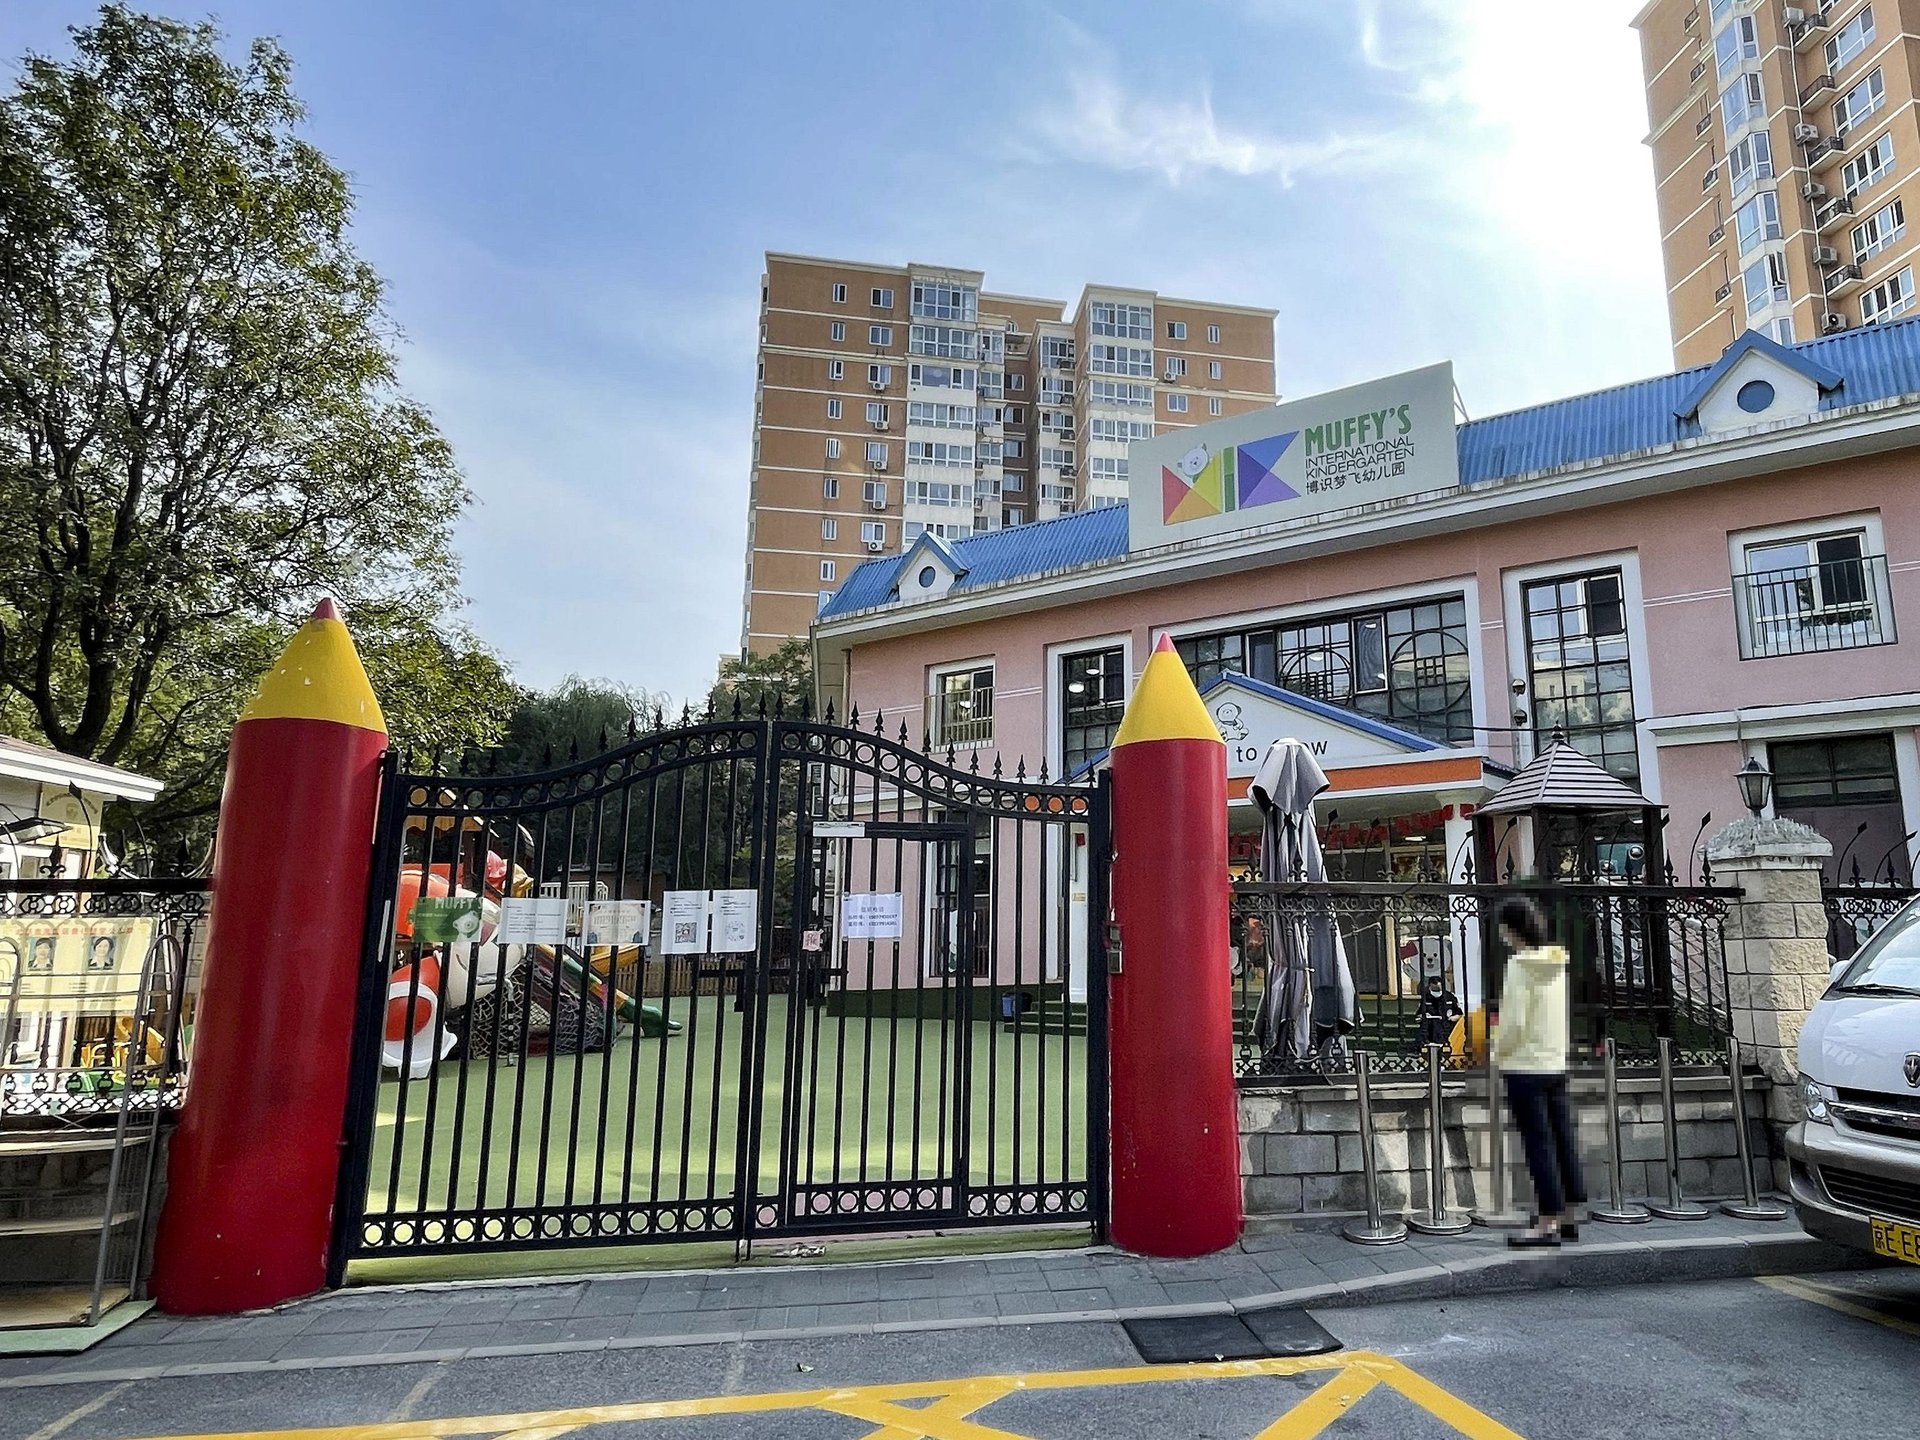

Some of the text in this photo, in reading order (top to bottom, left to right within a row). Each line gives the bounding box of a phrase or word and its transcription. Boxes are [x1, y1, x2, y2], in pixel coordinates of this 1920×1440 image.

[1304, 404, 1412, 457] MUFFY'S
[1305, 435, 1415, 469] INTERNATIONAL
[1305, 446, 1415, 480] KINDERGARTEN
[1305, 461, 1405, 495] 博识梦飞幼儿园
[1236, 746, 1258, 762] to
[434, 897, 483, 909] MUFFYS
